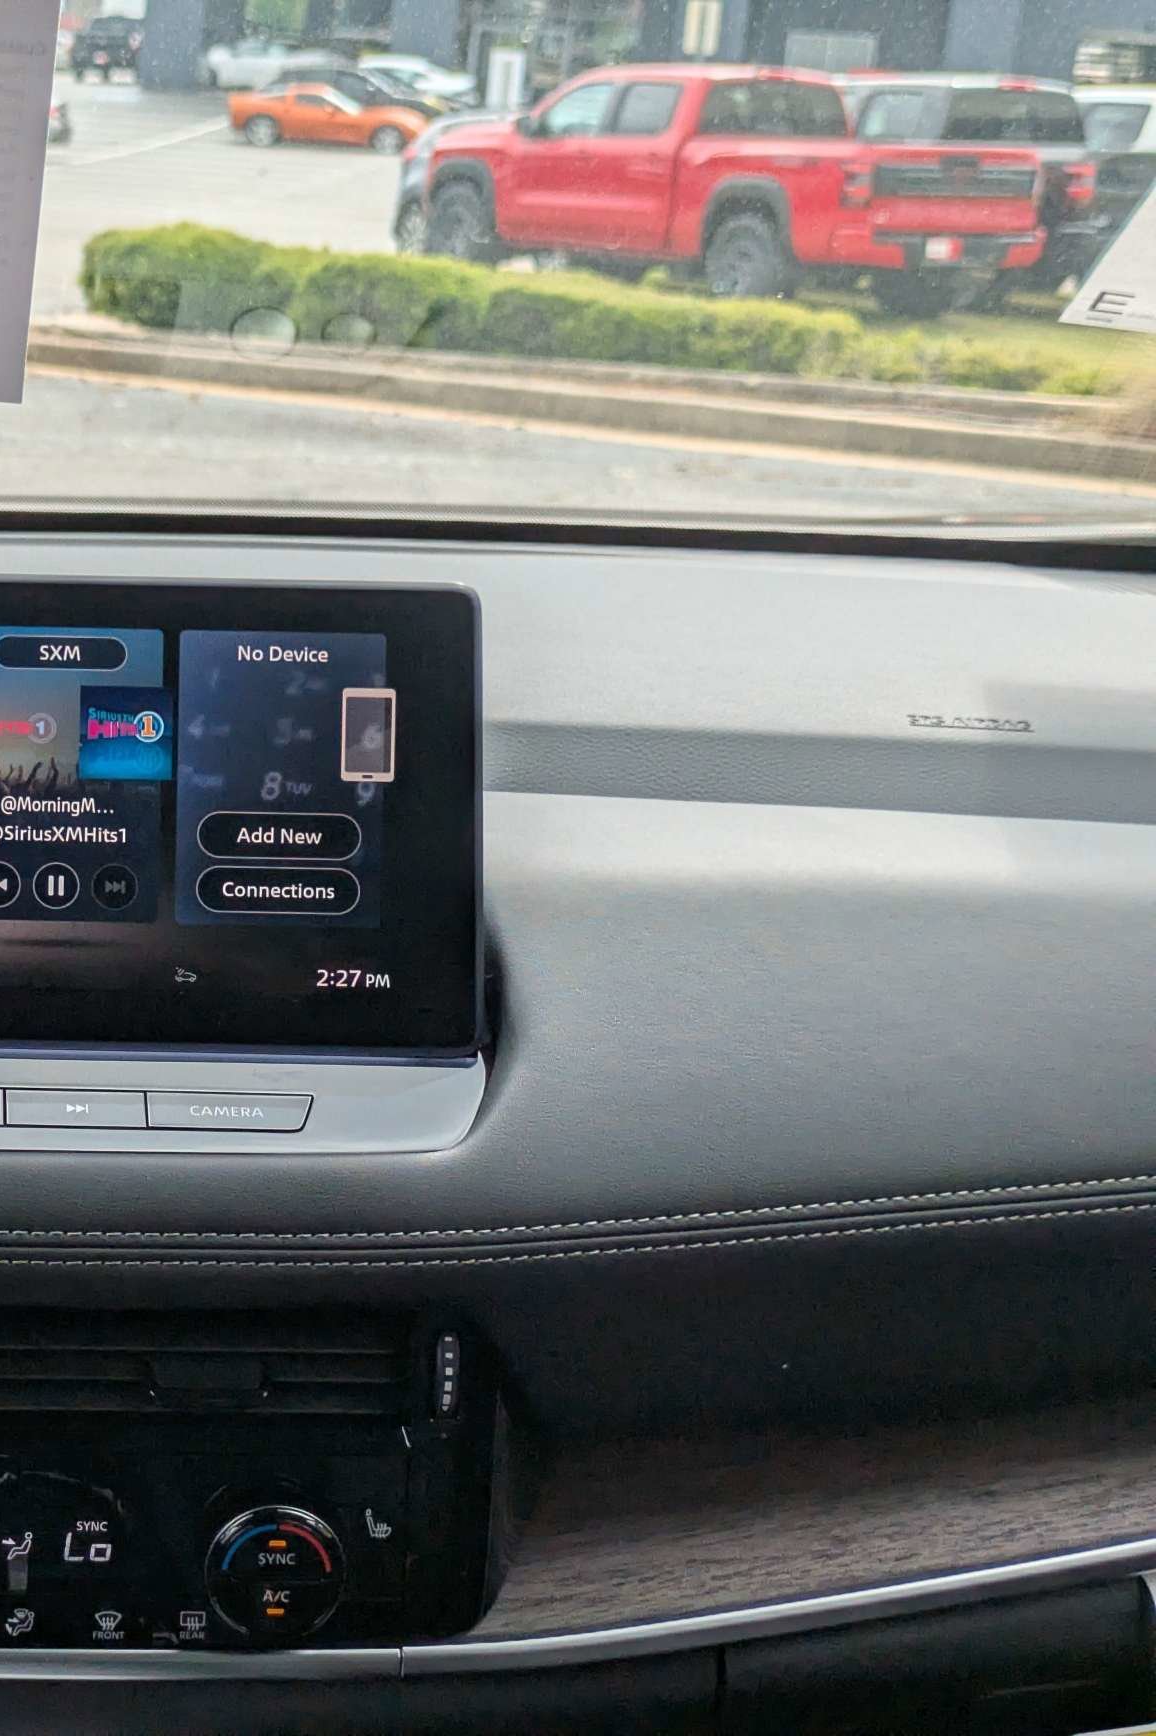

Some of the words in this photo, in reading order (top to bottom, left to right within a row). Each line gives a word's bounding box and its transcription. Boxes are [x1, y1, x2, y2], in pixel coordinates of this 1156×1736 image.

[39, 645, 82, 662] SXM
[237, 645, 265, 662] No
[269, 646, 330, 663] Device
[237, 827, 275, 844] Add
[280, 828, 323, 845] New
[222, 881, 336, 900] Connections
[316, 969, 362, 988] 2:27
[365, 973, 391, 989] PM
[189, 1105, 264, 1119] CAMERA
[76, 1521, 108, 1532] SYNC
[258, 1552, 296, 1566] SYNC
[262, 1589, 290, 1604] A/C
[92, 1631, 124, 1640] FRONT
[179, 1631, 205, 1640] REAR
